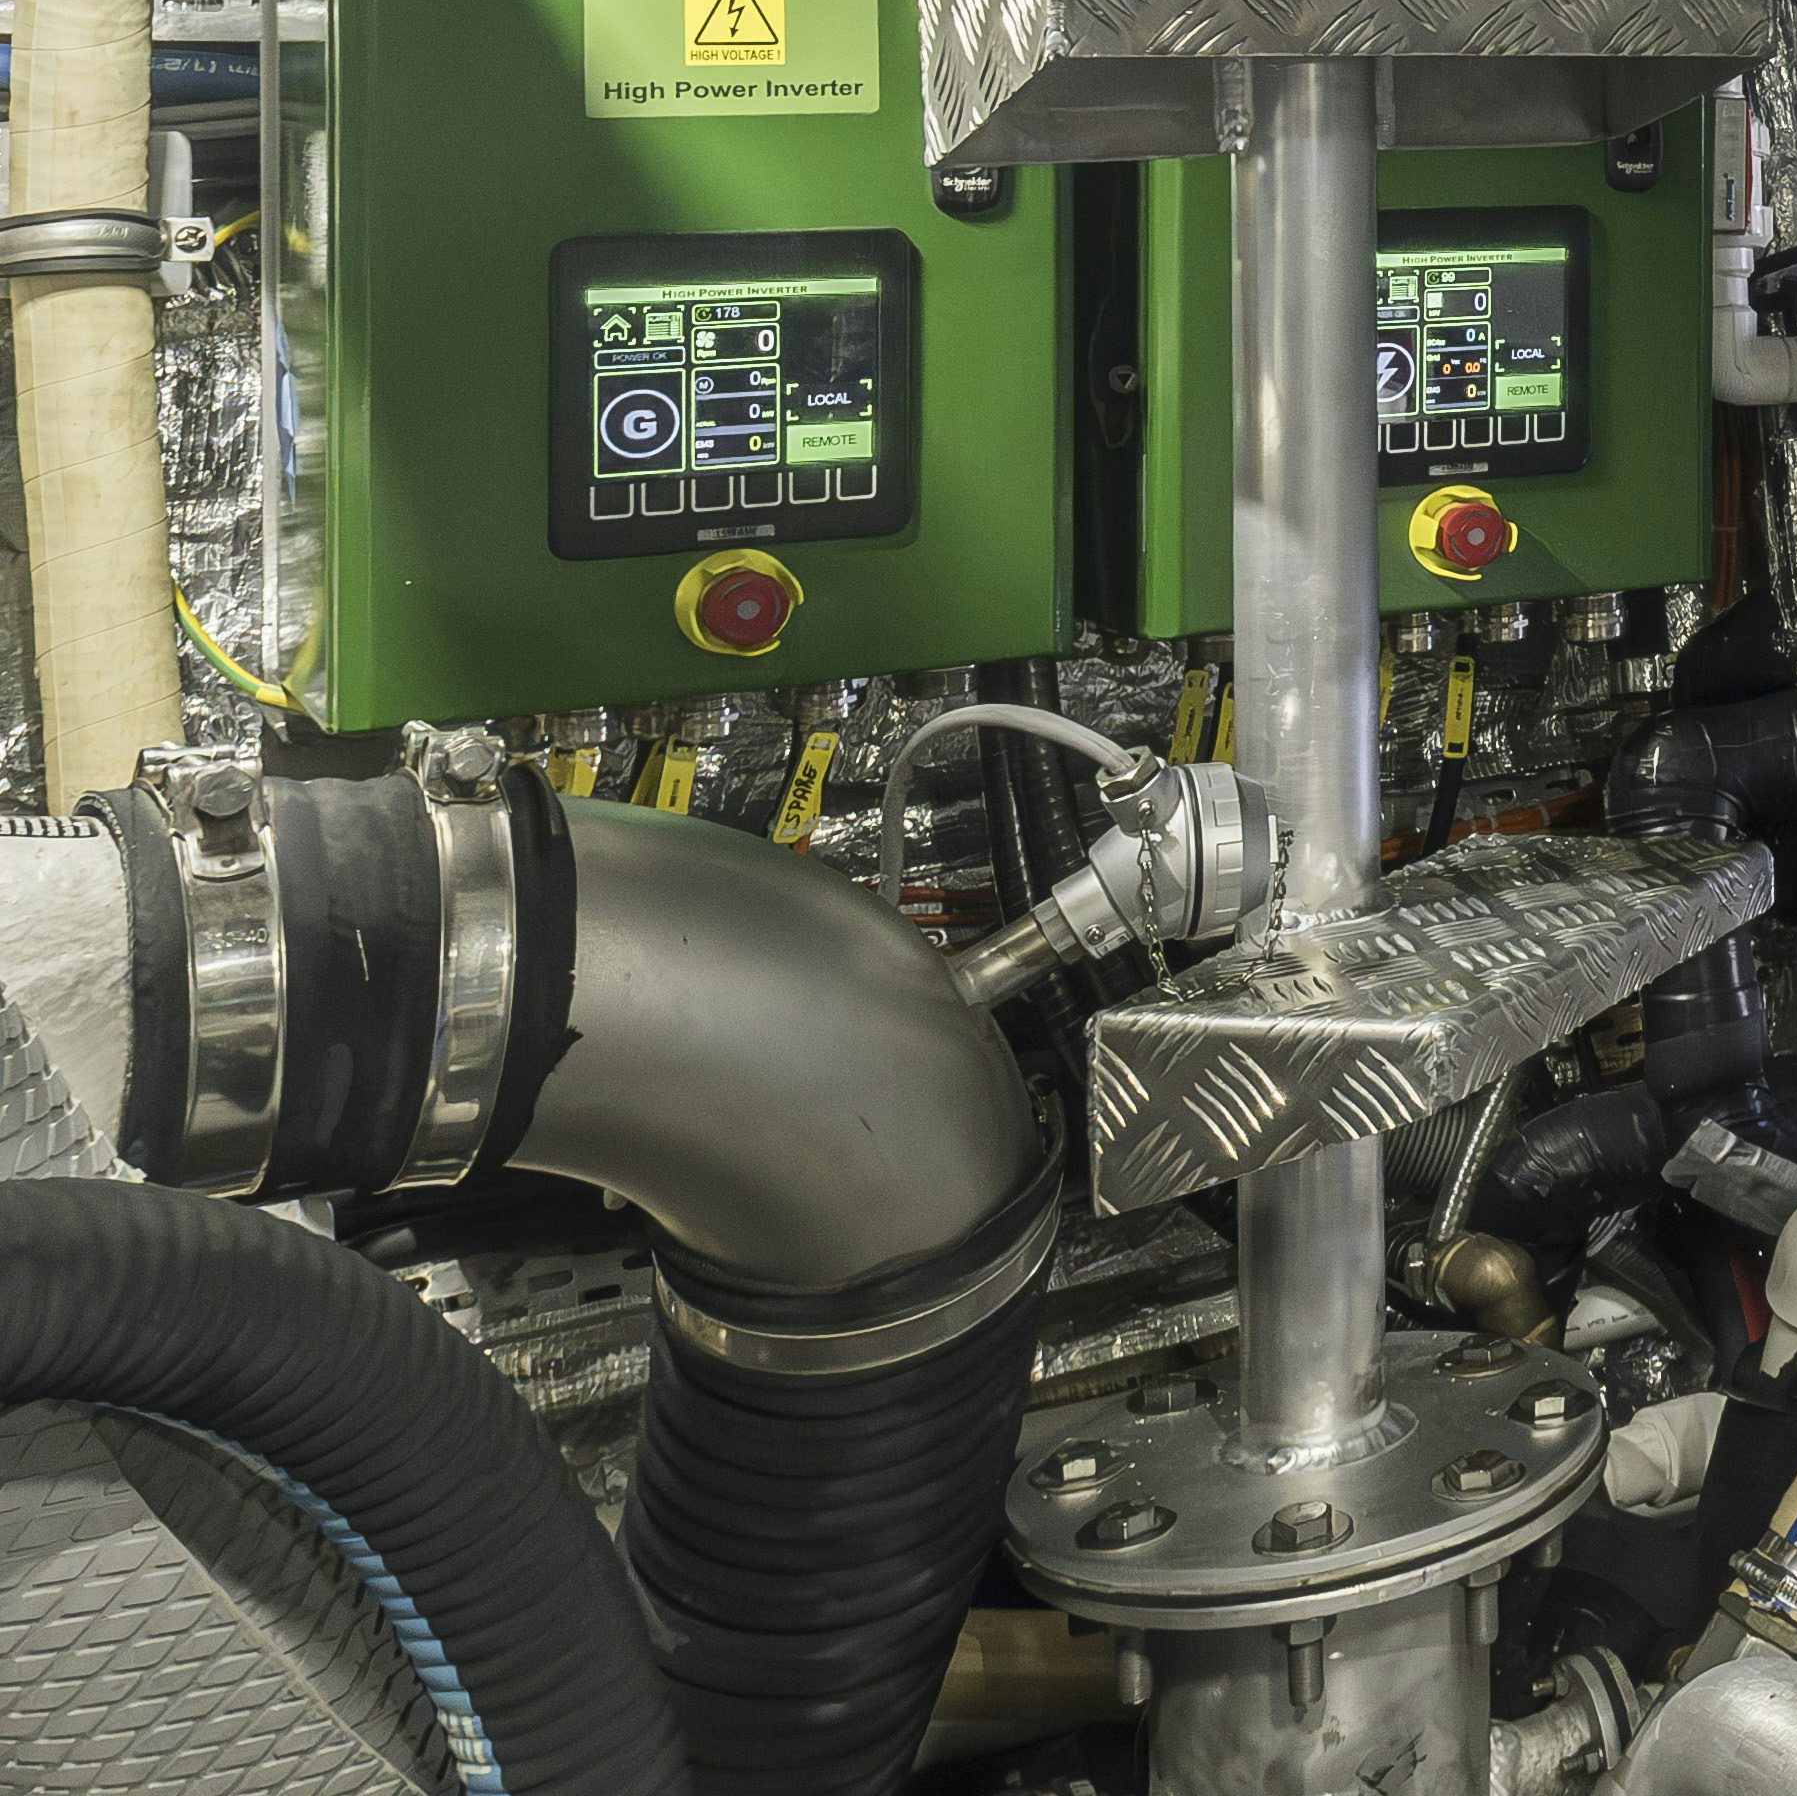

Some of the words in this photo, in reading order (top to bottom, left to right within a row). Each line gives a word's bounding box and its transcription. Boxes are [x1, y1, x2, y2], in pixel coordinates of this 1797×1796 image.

[690, 48, 719, 62] HIGH
[722, 48, 774, 62] VOLTAGE
[603, 82, 665, 103] High
[675, 81, 757, 99] Power
[766, 79, 864, 97] Inverter
[1441, 272, 1456, 282] 99
[1474, 293, 1487, 311] 0
[715, 307, 740, 318] 178
[758, 329, 775, 352] 0
[1466, 328, 1476, 342] 0
[1478, 332, 1486, 341] A
[1511, 349, 1545, 360] LOCAL
[1442, 363, 1451, 374] 0
[749, 370, 761, 386] 0
[1466, 384, 1477, 398] 0
[1507, 385, 1549, 396] REMOTE
[807, 392, 852, 406] LOCAL
[749, 403, 760, 419] 0
[623, 410, 657, 440] G
[749, 435, 762, 452] 0
[802, 433, 857, 449] REMOTE
[785, 760, 817, 828] SPARE
